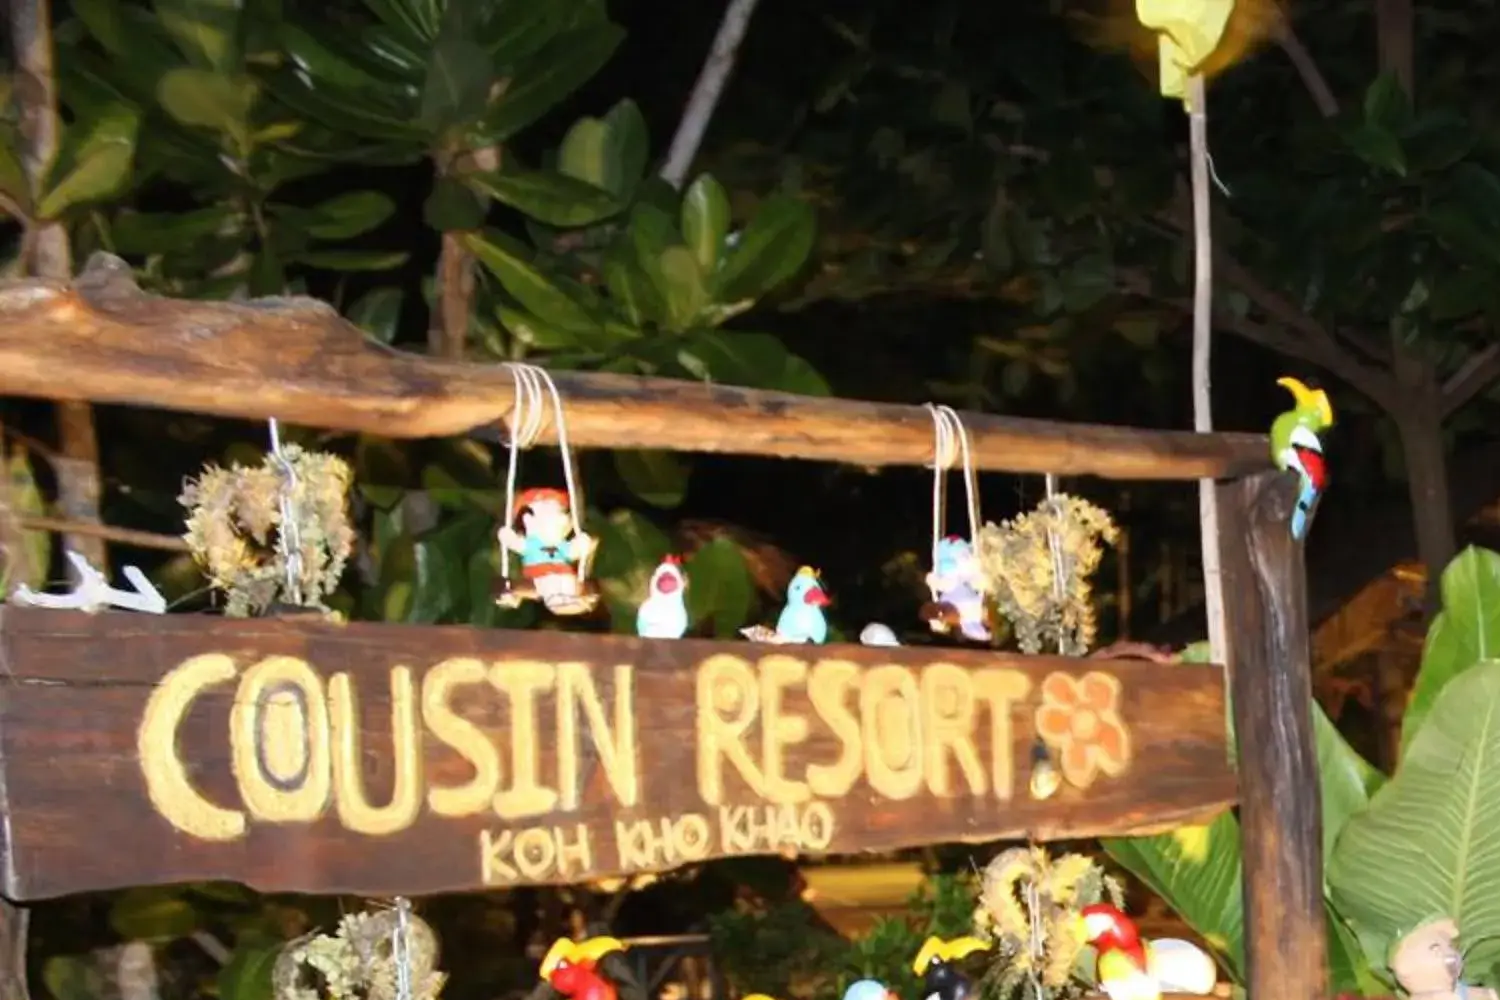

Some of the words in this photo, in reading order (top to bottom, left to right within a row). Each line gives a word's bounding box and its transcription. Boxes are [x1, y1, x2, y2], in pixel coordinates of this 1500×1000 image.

[137, 652, 641, 842] COUSIN
[696, 653, 1032, 806] RESORT
[479, 823, 594, 884] KOH
[614, 812, 709, 870] KHO
[717, 802, 834, 858] KHAO
